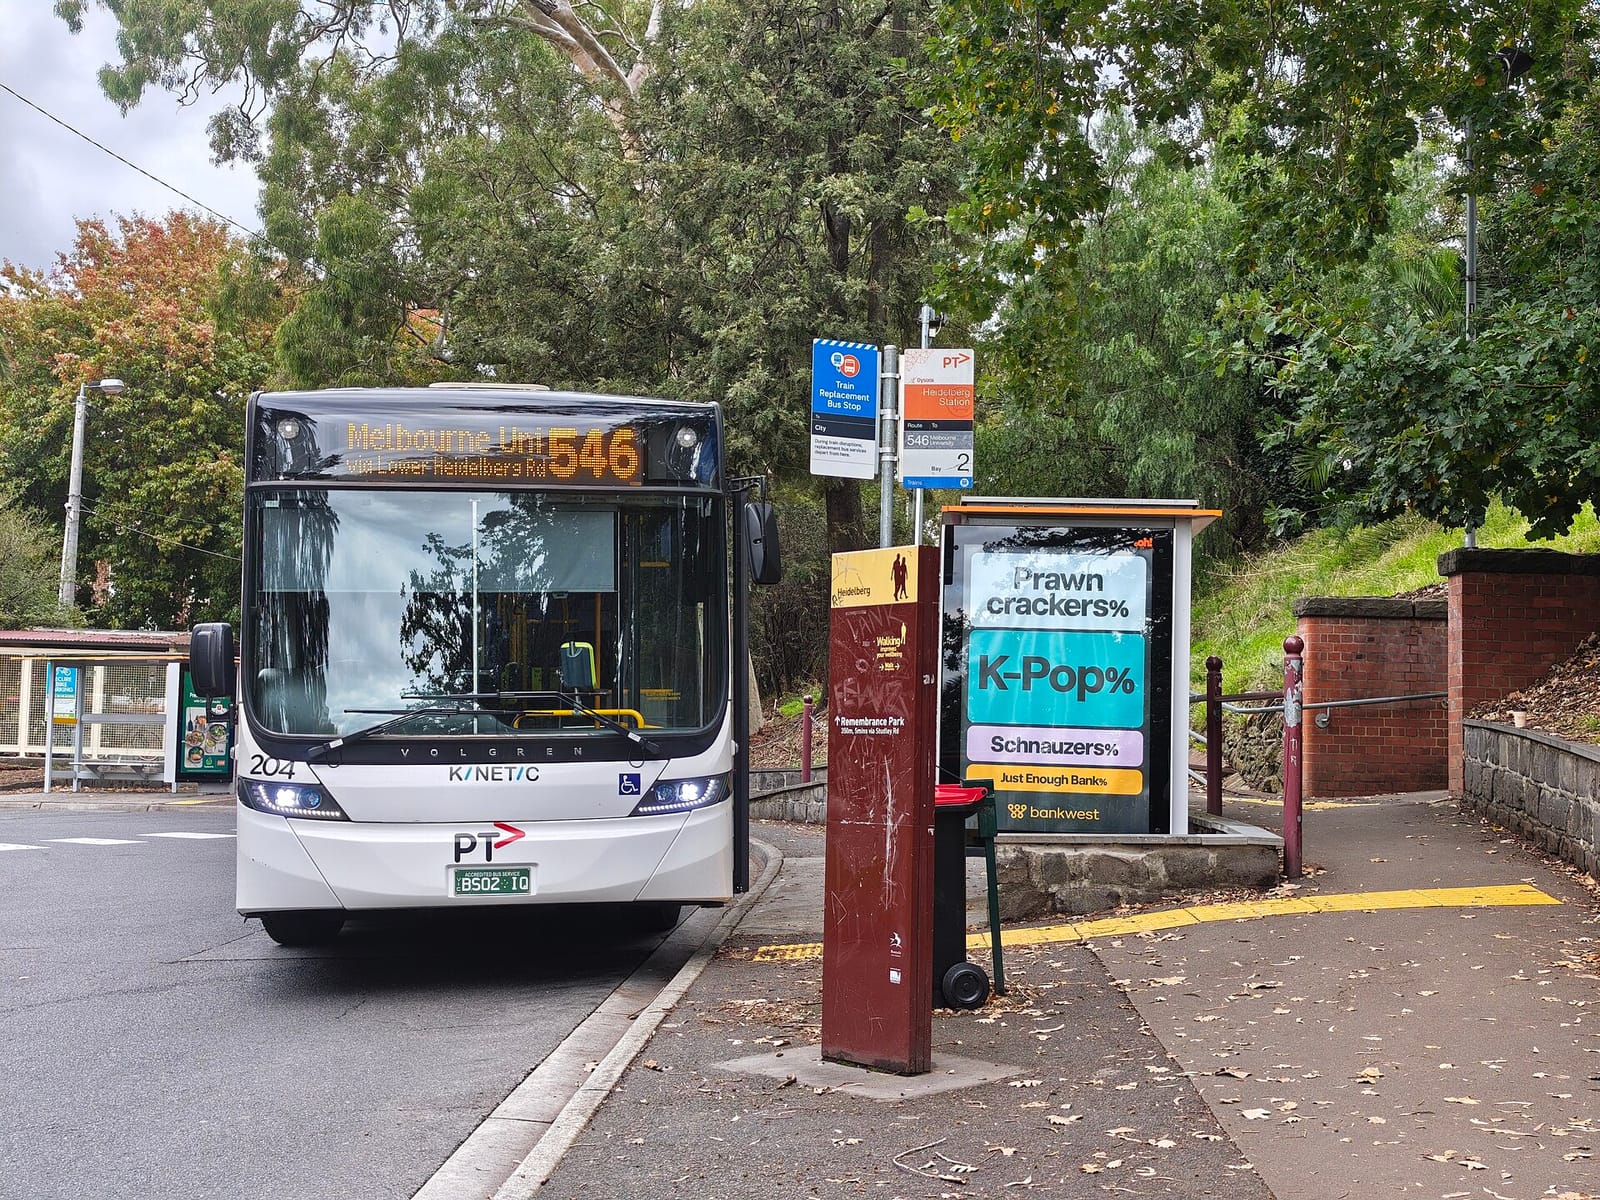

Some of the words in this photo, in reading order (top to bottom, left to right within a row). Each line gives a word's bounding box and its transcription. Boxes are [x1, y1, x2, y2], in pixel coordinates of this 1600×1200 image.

[943, 357, 960, 368] PT
[835, 380, 855, 390] Train
[819, 388, 870, 402] Replacement
[922, 388, 970, 398] Heidelberg
[827, 400, 842, 409] Bus
[843, 401, 861, 412] Stop
[939, 398, 970, 406] Station
[814, 424, 827, 433] City
[347, 423, 491, 452] Melbourne
[499, 426, 542, 454] Uni
[907, 434, 930, 446] 546
[548, 427, 639, 479] 546
[346, 455, 373, 474] via
[377, 455, 429, 475] Lower
[434, 456, 521, 477] Heidelberg
[526, 458, 546, 477] Rd
[957, 453, 970, 472] 2
[1013, 566, 1104, 592] Prawn
[837, 586, 870, 597] Heidelberg
[986, 592, 1130, 618] crackers%
[876, 636, 900, 648] Walking
[978, 654, 1135, 702] K-Pop%
[840, 716, 888, 726] Remembrance
[888, 716, 904, 726] Park
[400, 748, 582, 758] VOLGREN
[990, 736, 1119, 756] Schnauzers%
[250, 754, 296, 780] 204
[1000, 772, 1024, 784] Just
[1026, 774, 1069, 787] Enough
[1071, 775, 1108, 786] Bank%
[1030, 806, 1100, 821] bankwest
[454, 832, 500, 863] PT
